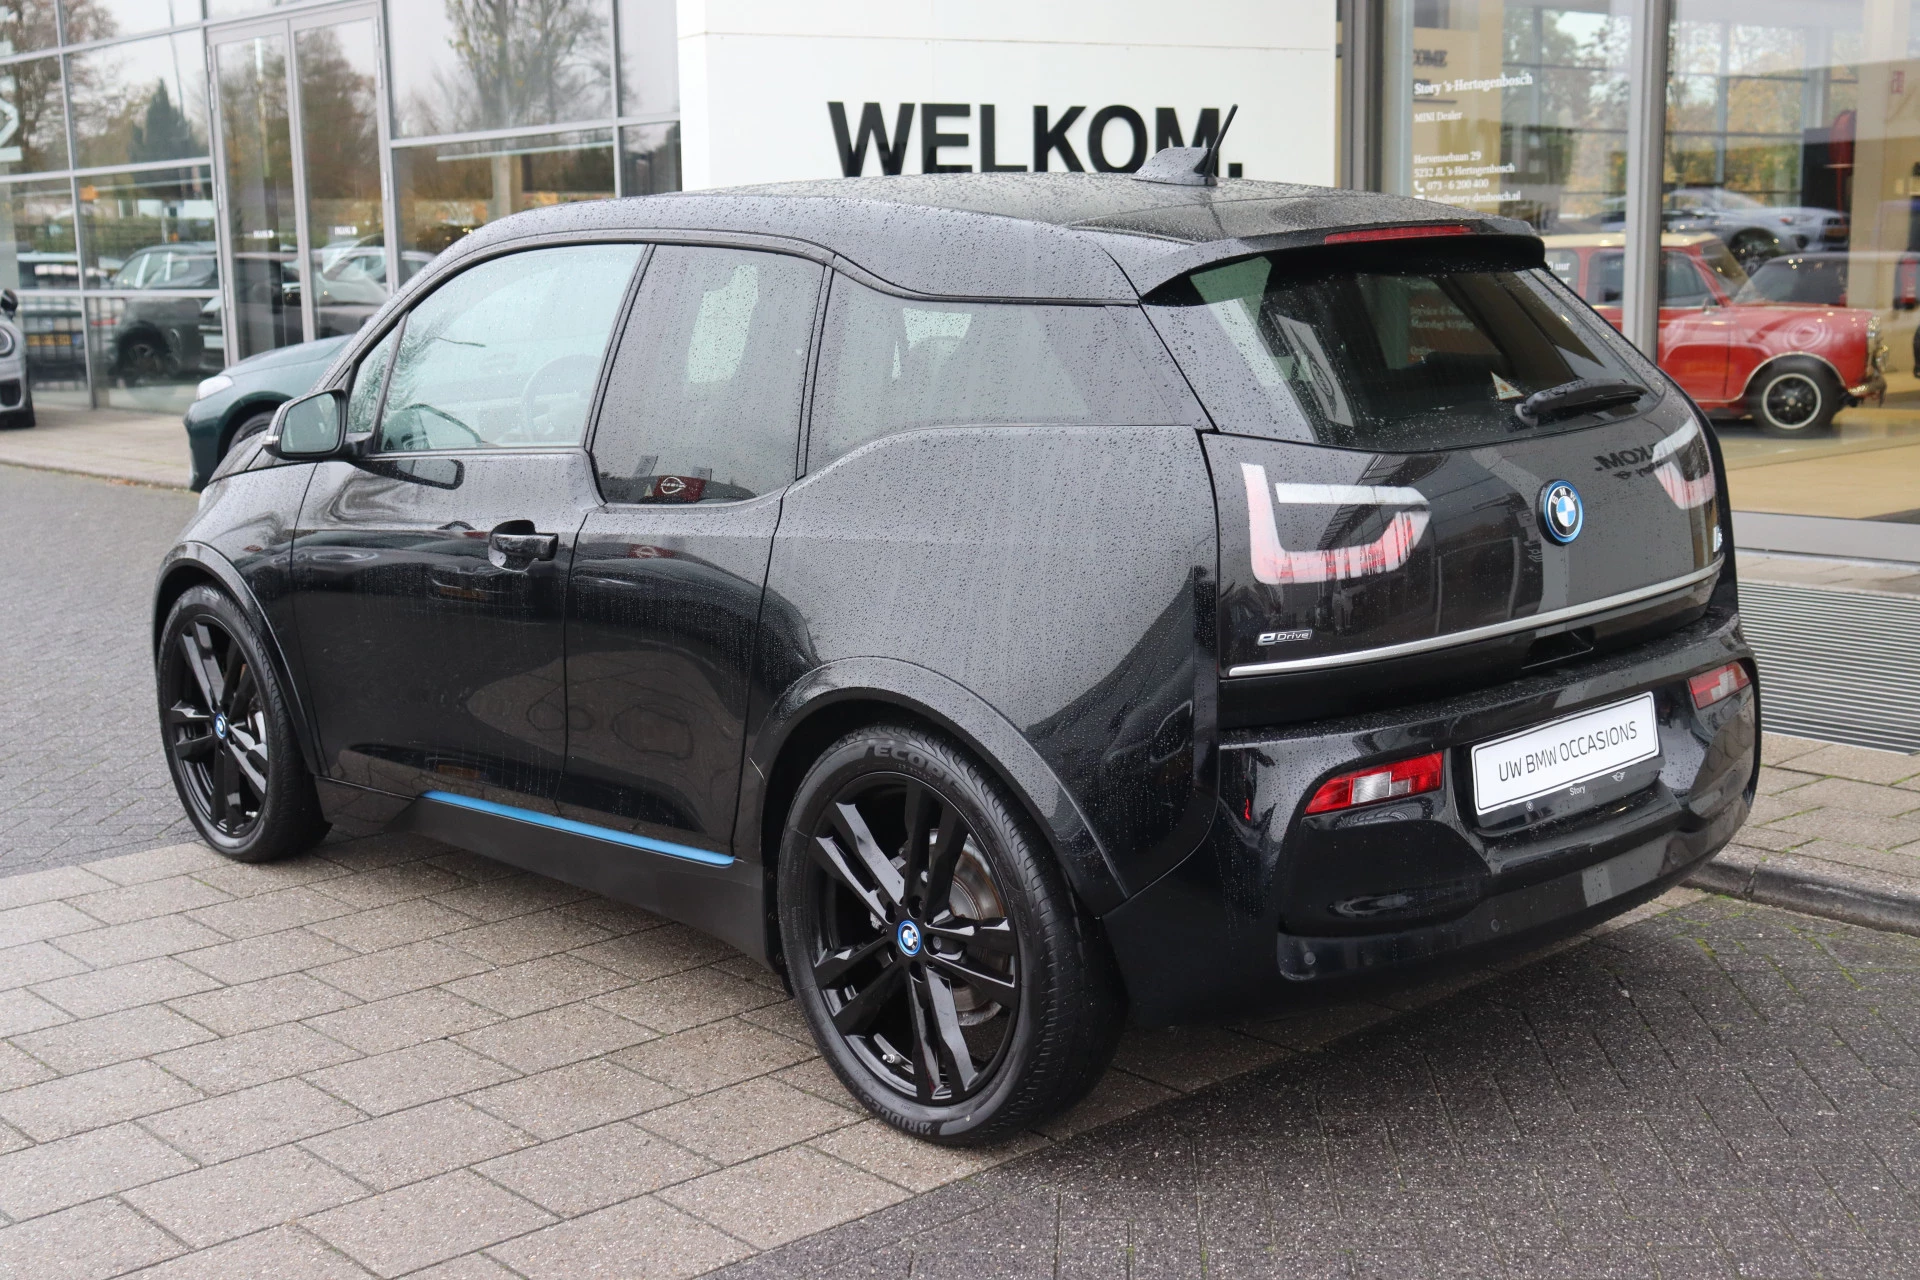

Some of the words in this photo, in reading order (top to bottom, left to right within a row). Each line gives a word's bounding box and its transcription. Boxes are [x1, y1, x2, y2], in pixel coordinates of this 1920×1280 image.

[1414, 83, 1441, 96] Story
[1414, 112, 1435, 122] MINI
[1437, 110, 1463, 121] Dealer
[827, 102, 1243, 178] WELKOM.
[1470, 151, 1481, 161] 29
[1551, 487, 1577, 505] BMW
[1498, 757, 1522, 782] UW
[1526, 746, 1557, 774] BMW
[1560, 720, 1637, 762] OCCASIONS
[1569, 785, 1586, 796] Story
